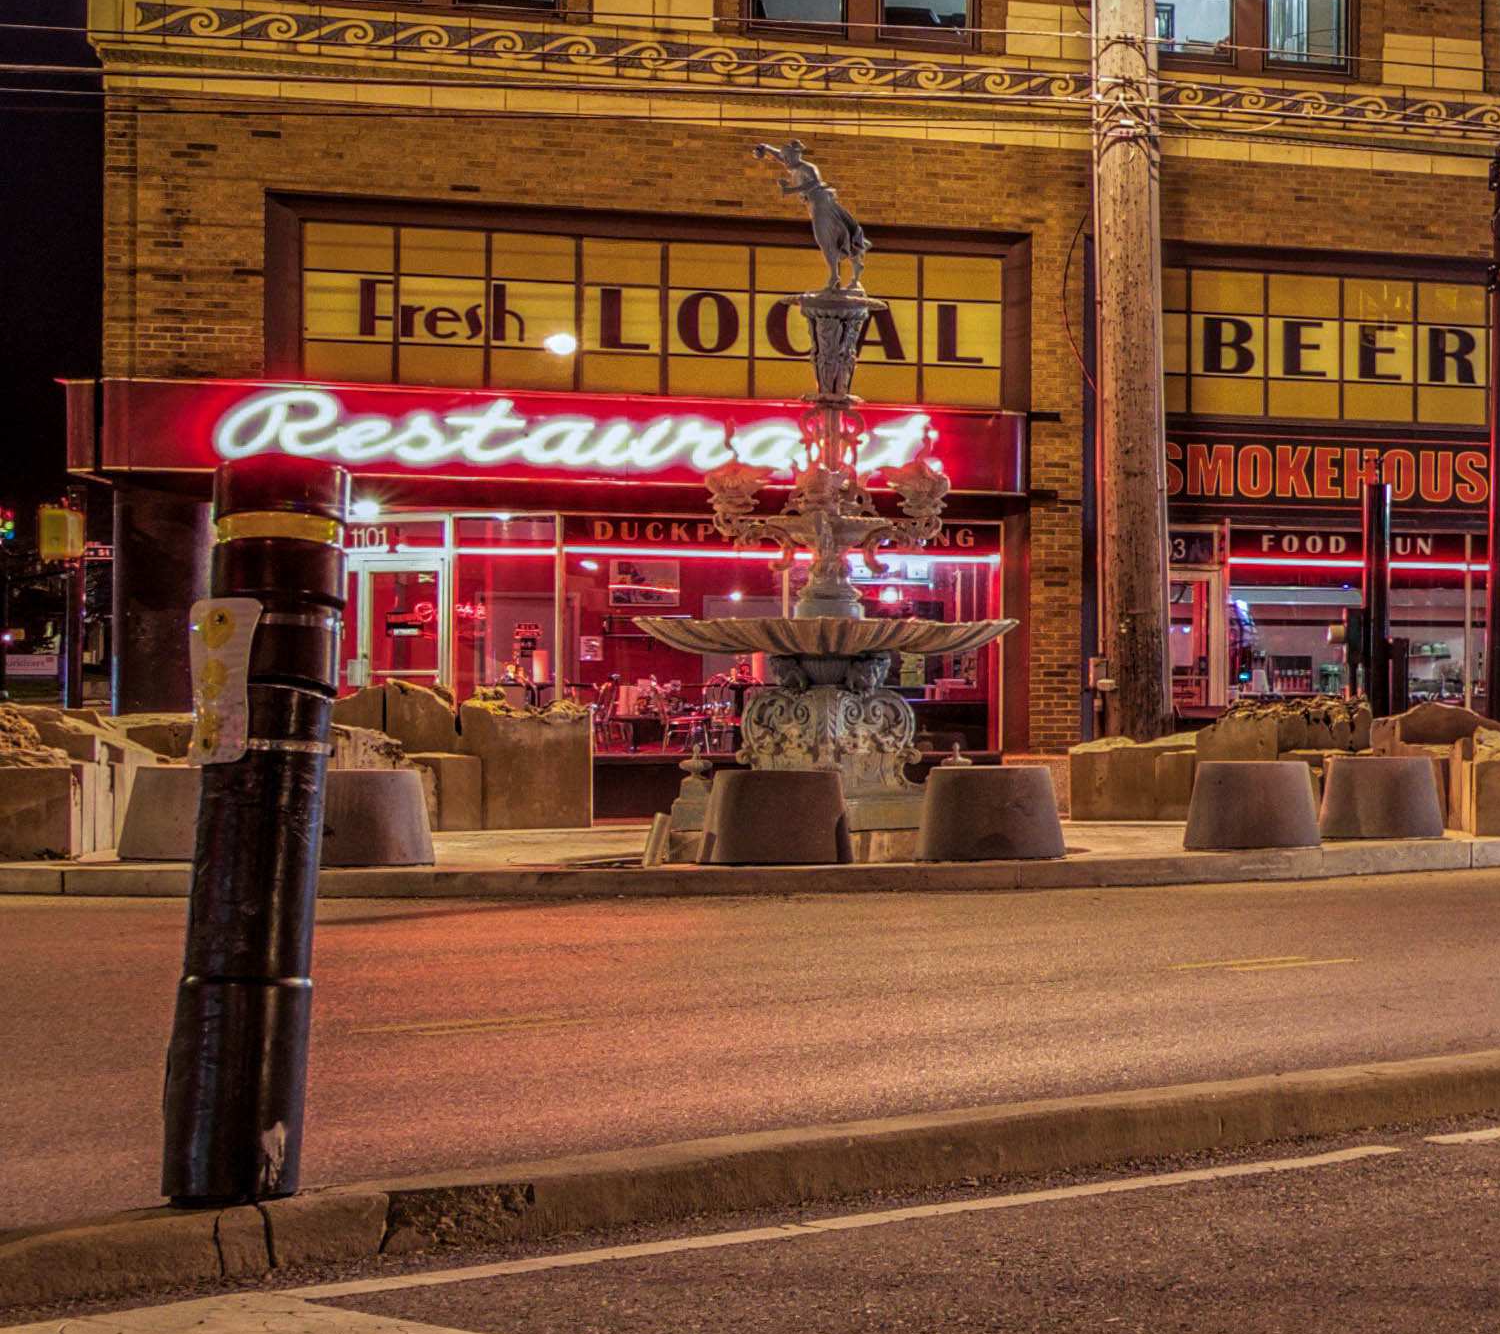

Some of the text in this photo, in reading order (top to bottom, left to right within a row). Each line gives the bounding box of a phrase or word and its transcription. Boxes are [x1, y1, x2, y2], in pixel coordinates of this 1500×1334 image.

[359, 278, 984, 365] Fresh LOCAL
[1166, 440, 1491, 504] SMOKEHOUS
[351, 527, 388, 548] 1101
[1261, 533, 1347, 554] FOOD
[1394, 535, 1433, 556] UN
